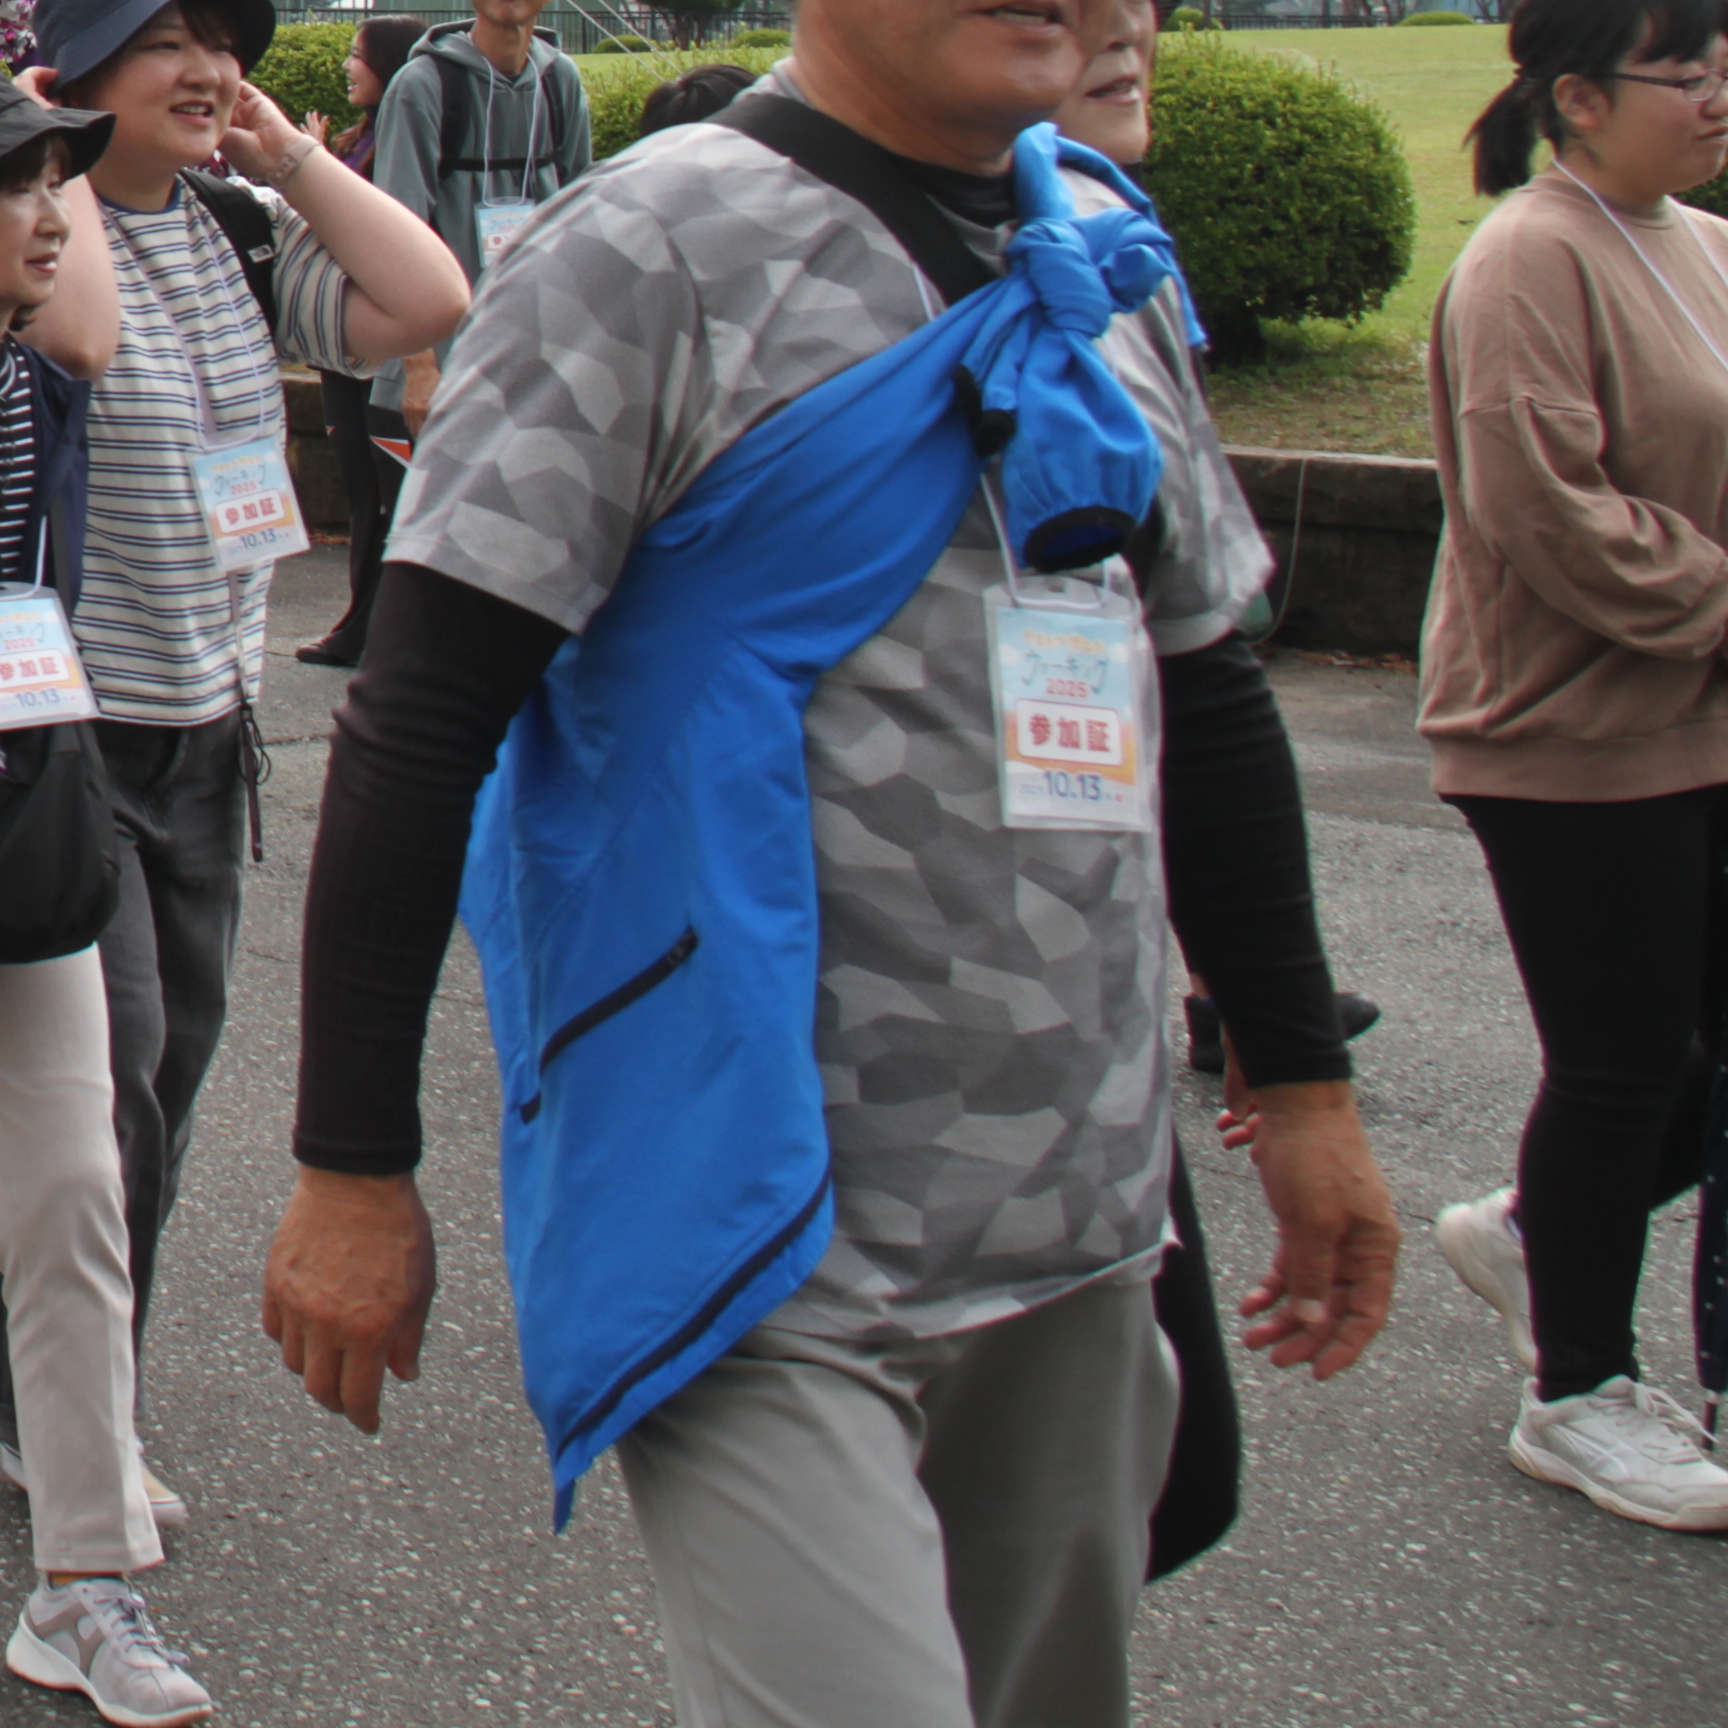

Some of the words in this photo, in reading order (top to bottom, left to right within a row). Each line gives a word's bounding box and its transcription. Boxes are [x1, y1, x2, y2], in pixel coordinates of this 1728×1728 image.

[224, 497, 276, 525] 参加証
[239, 528, 276, 549] 10.13
[3, 637, 36, 650] 2025
[15, 688, 60, 708] 10.13
[1046, 678, 1089, 699] 2025
[1028, 713, 1111, 753] 参加証
[1044, 771, 1101, 801] 10.13
